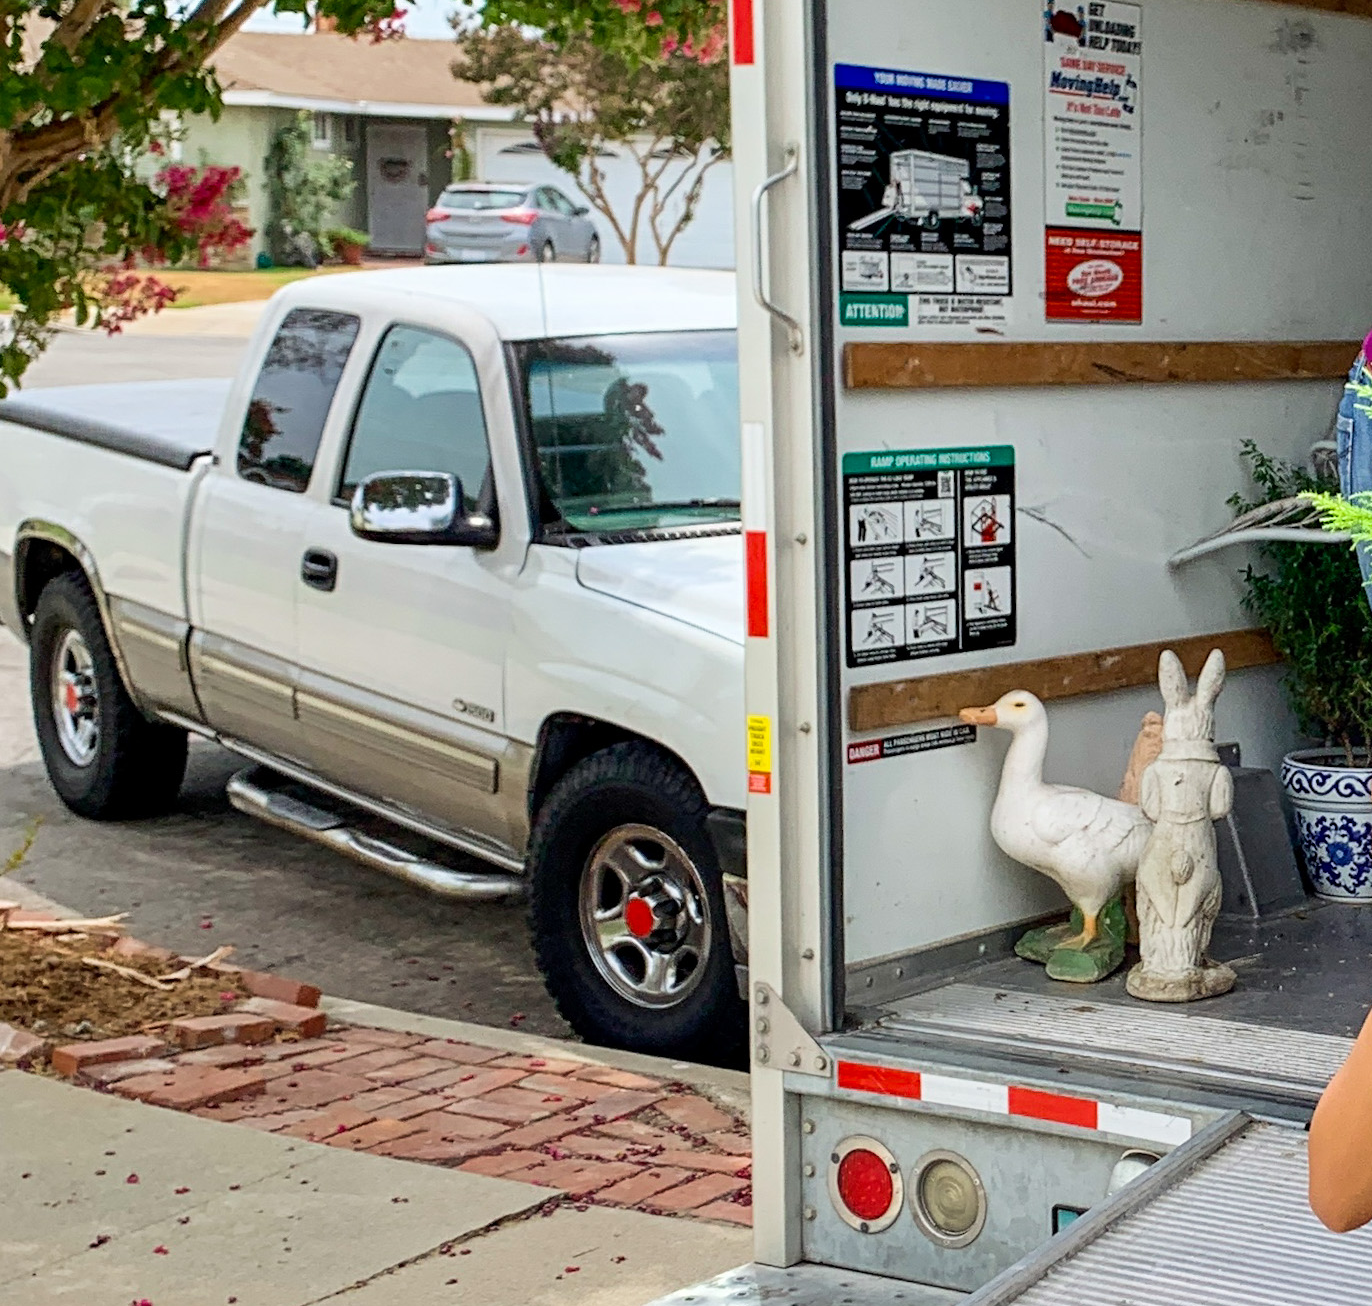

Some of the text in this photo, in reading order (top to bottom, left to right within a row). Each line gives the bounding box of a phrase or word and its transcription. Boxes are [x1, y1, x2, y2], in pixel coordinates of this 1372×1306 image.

[870, 450, 991, 469] RAMP OPERATING INSTRUCTIONS
